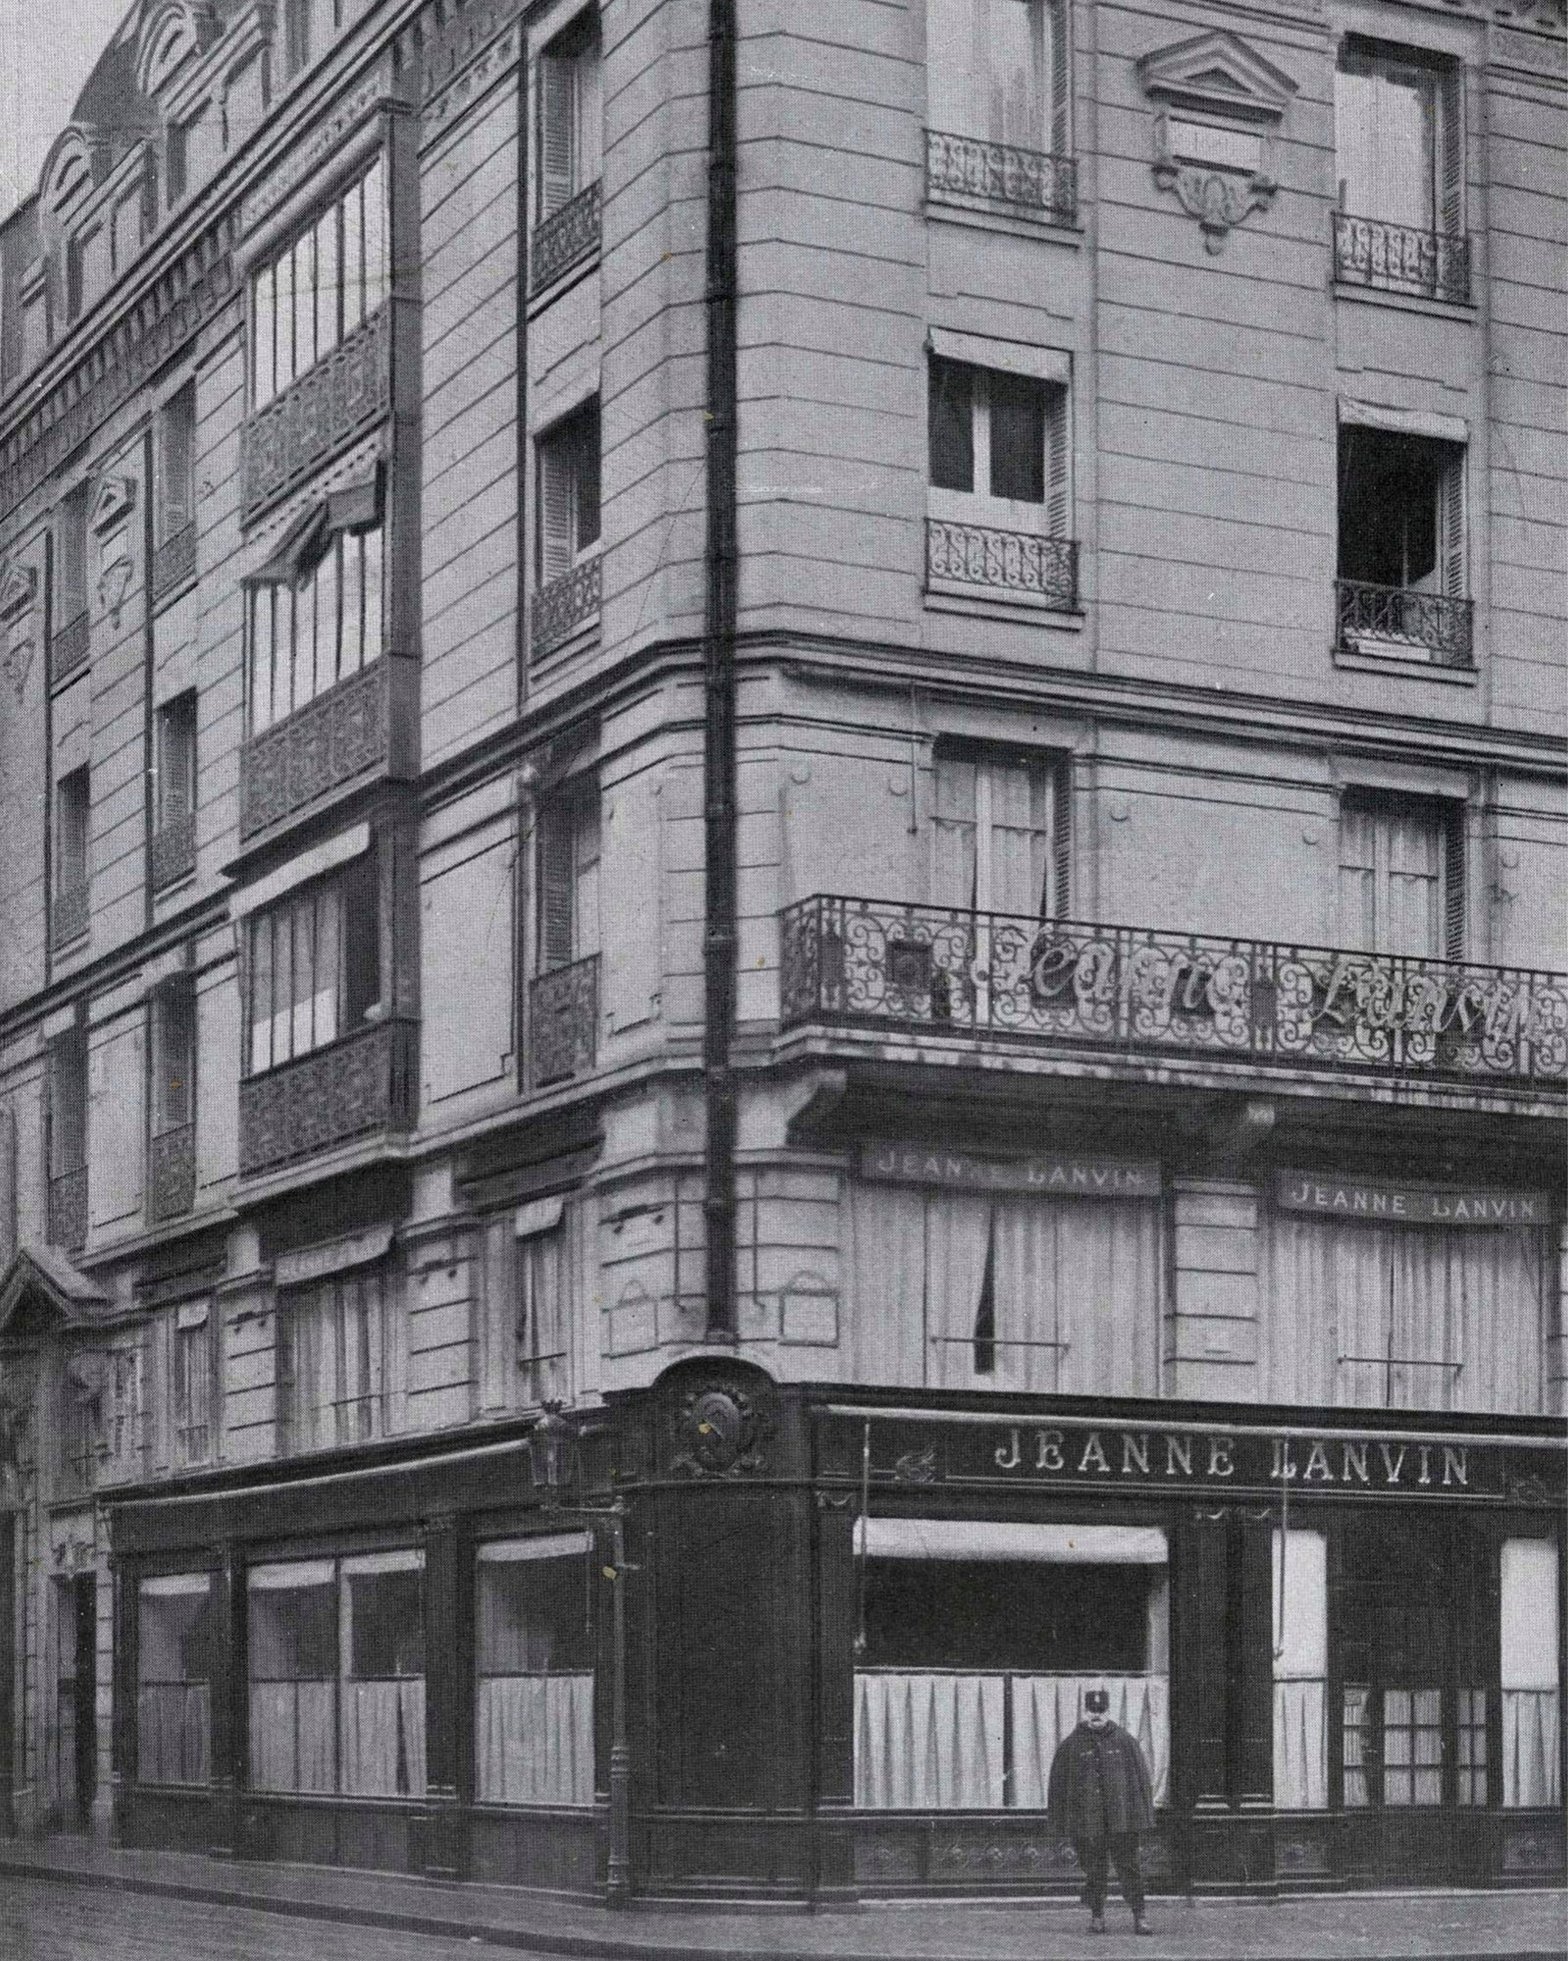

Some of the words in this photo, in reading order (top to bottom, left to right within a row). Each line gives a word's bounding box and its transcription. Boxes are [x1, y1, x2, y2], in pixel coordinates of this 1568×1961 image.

[1026, 1165, 1142, 1186] LANVIN
[1291, 1183, 1407, 1214] JEANNE
[1432, 1197, 1535, 1219] LANVIN
[994, 1428, 1234, 1476] JEANNE
[1270, 1437, 1469, 1485] LANVIN
